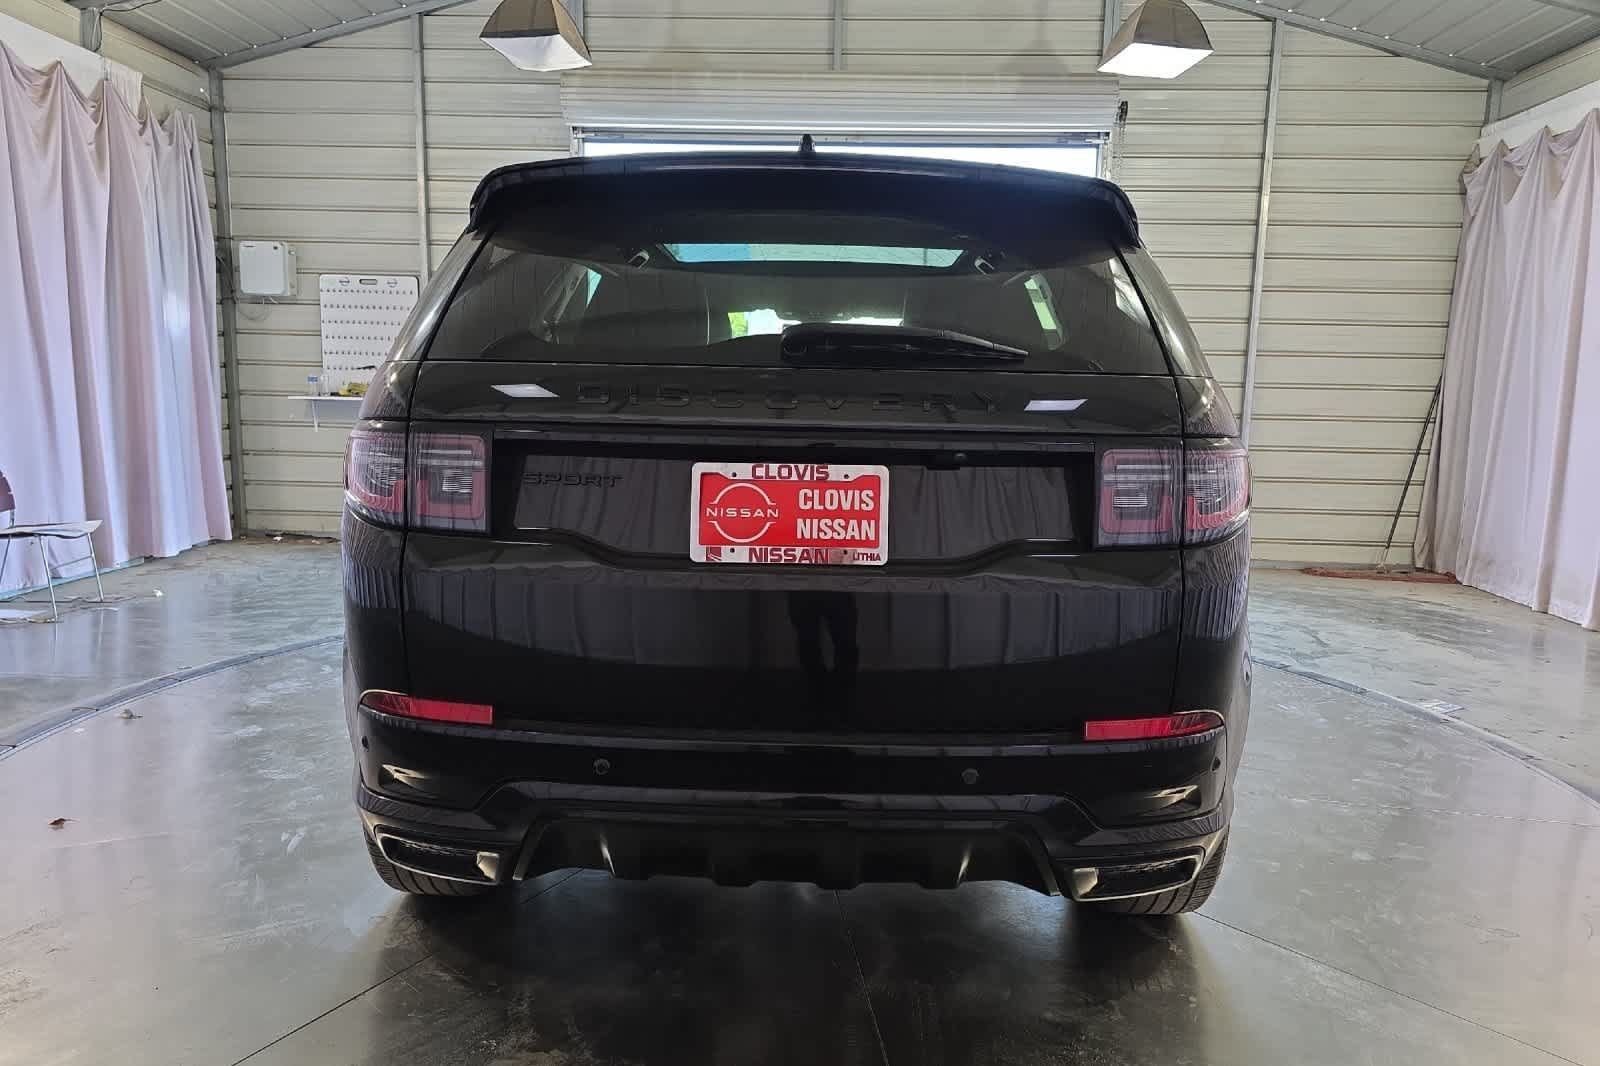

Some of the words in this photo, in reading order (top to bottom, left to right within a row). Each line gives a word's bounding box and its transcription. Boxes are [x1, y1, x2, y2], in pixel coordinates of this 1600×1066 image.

[576, 382, 1000, 415] DISCOVERY
[522, 471, 623, 488] SPORT
[752, 464, 829, 480] CLOVIS
[799, 488, 874, 511] CLOVIS
[705, 507, 779, 518] NISSAN
[797, 518, 876, 540] NISSAN
[749, 548, 829, 563] NISSAN
[852, 551, 881, 561] LITHIA
